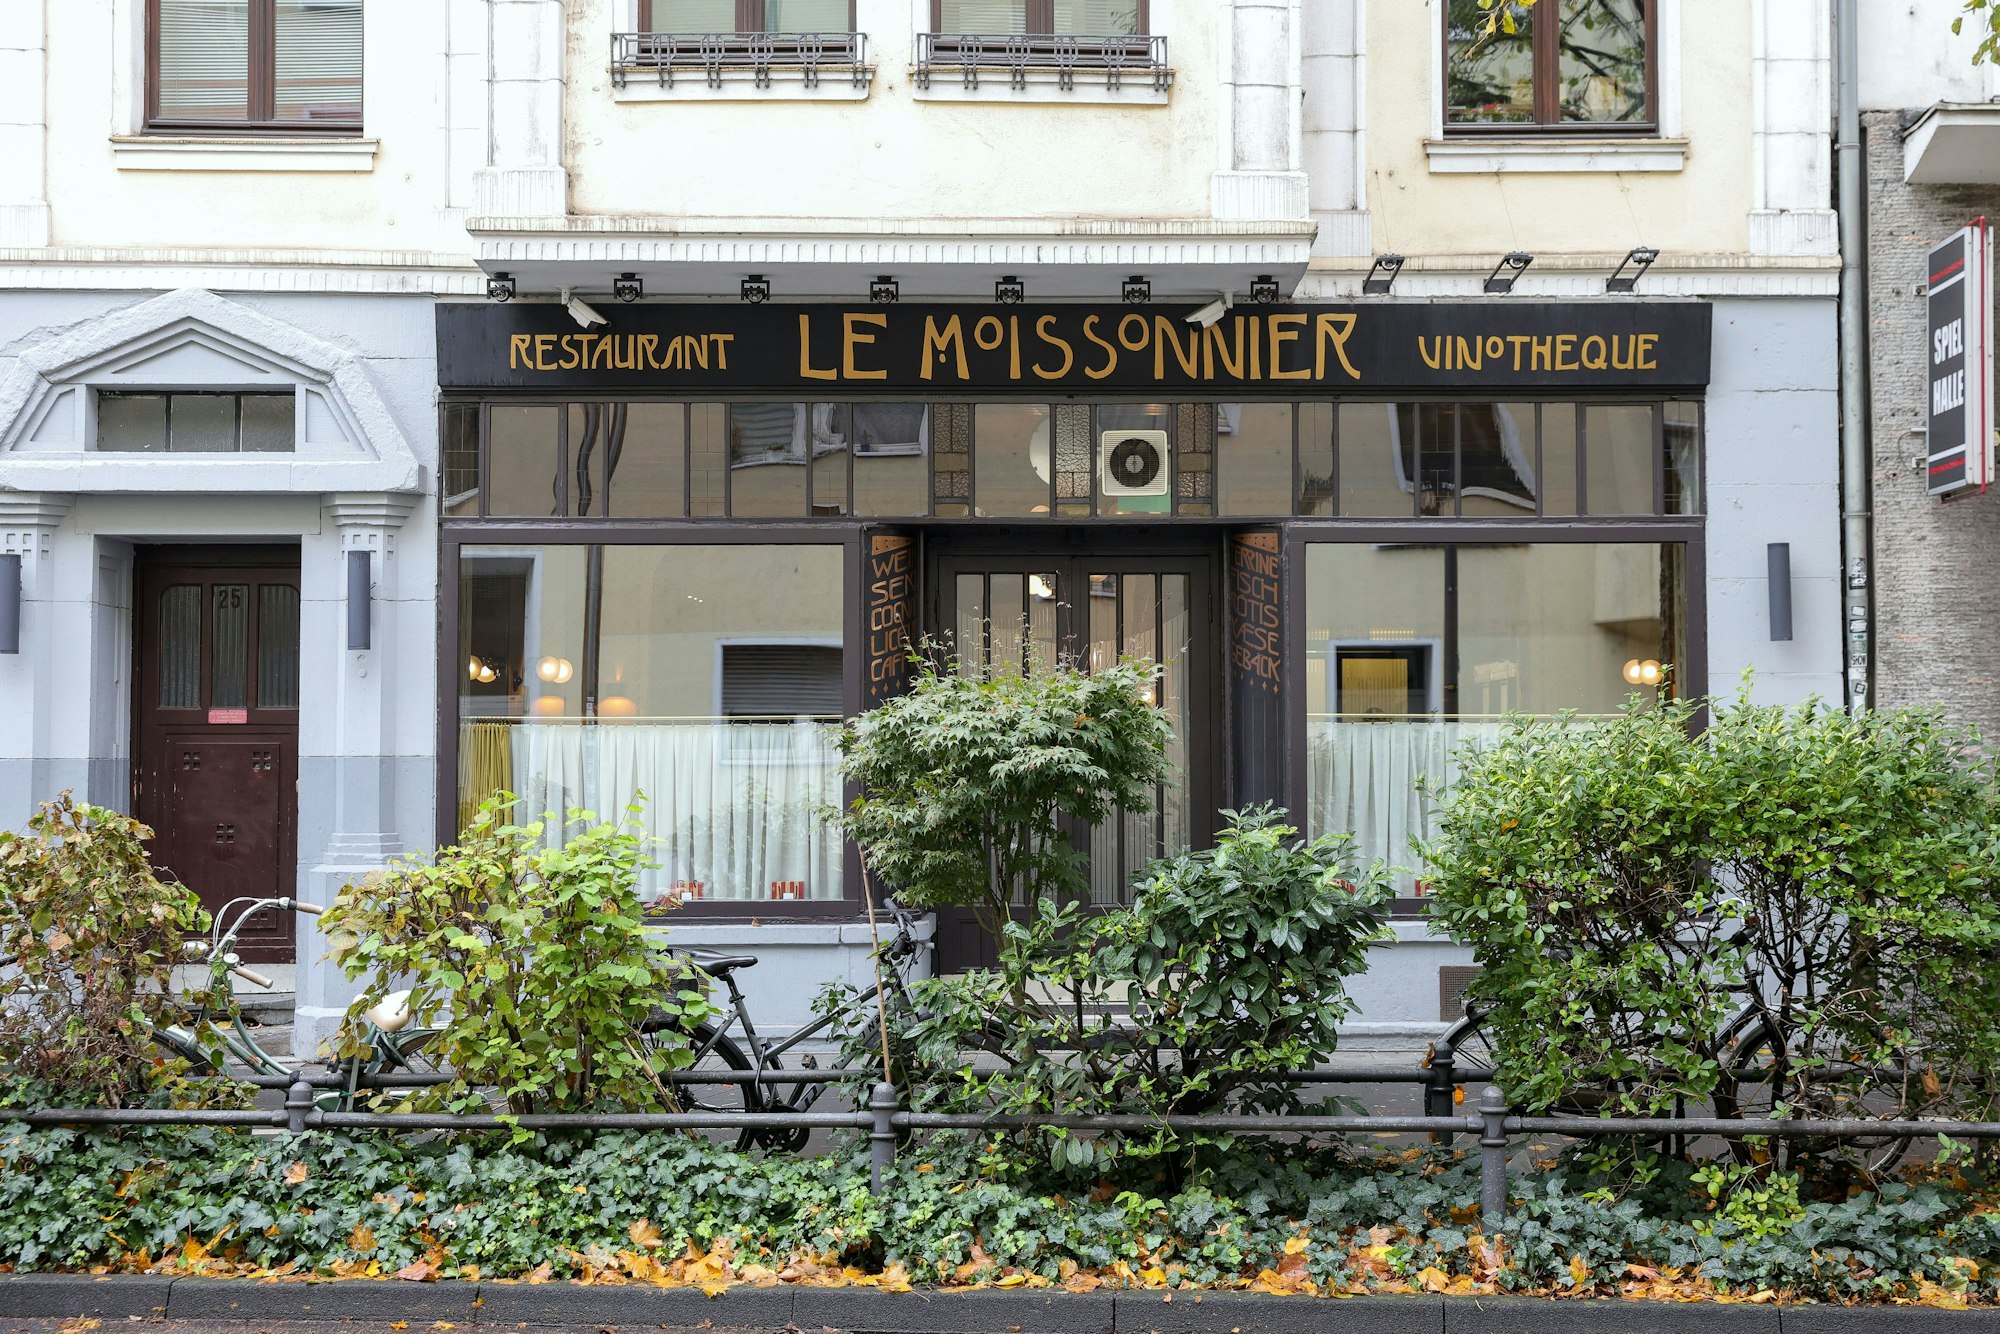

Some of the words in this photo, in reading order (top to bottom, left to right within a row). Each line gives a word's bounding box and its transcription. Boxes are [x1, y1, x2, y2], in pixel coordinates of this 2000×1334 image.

[510, 334, 733, 371] RESTAURANT
[800, 313, 887, 380] LE
[1418, 334, 1659, 371] VINOTHEQUE
[1934, 317, 1963, 365] SPIEL
[1932, 368, 1964, 416] HALLE
[1233, 546, 1279, 579] ERRINE
[219, 588, 241, 609] 25
